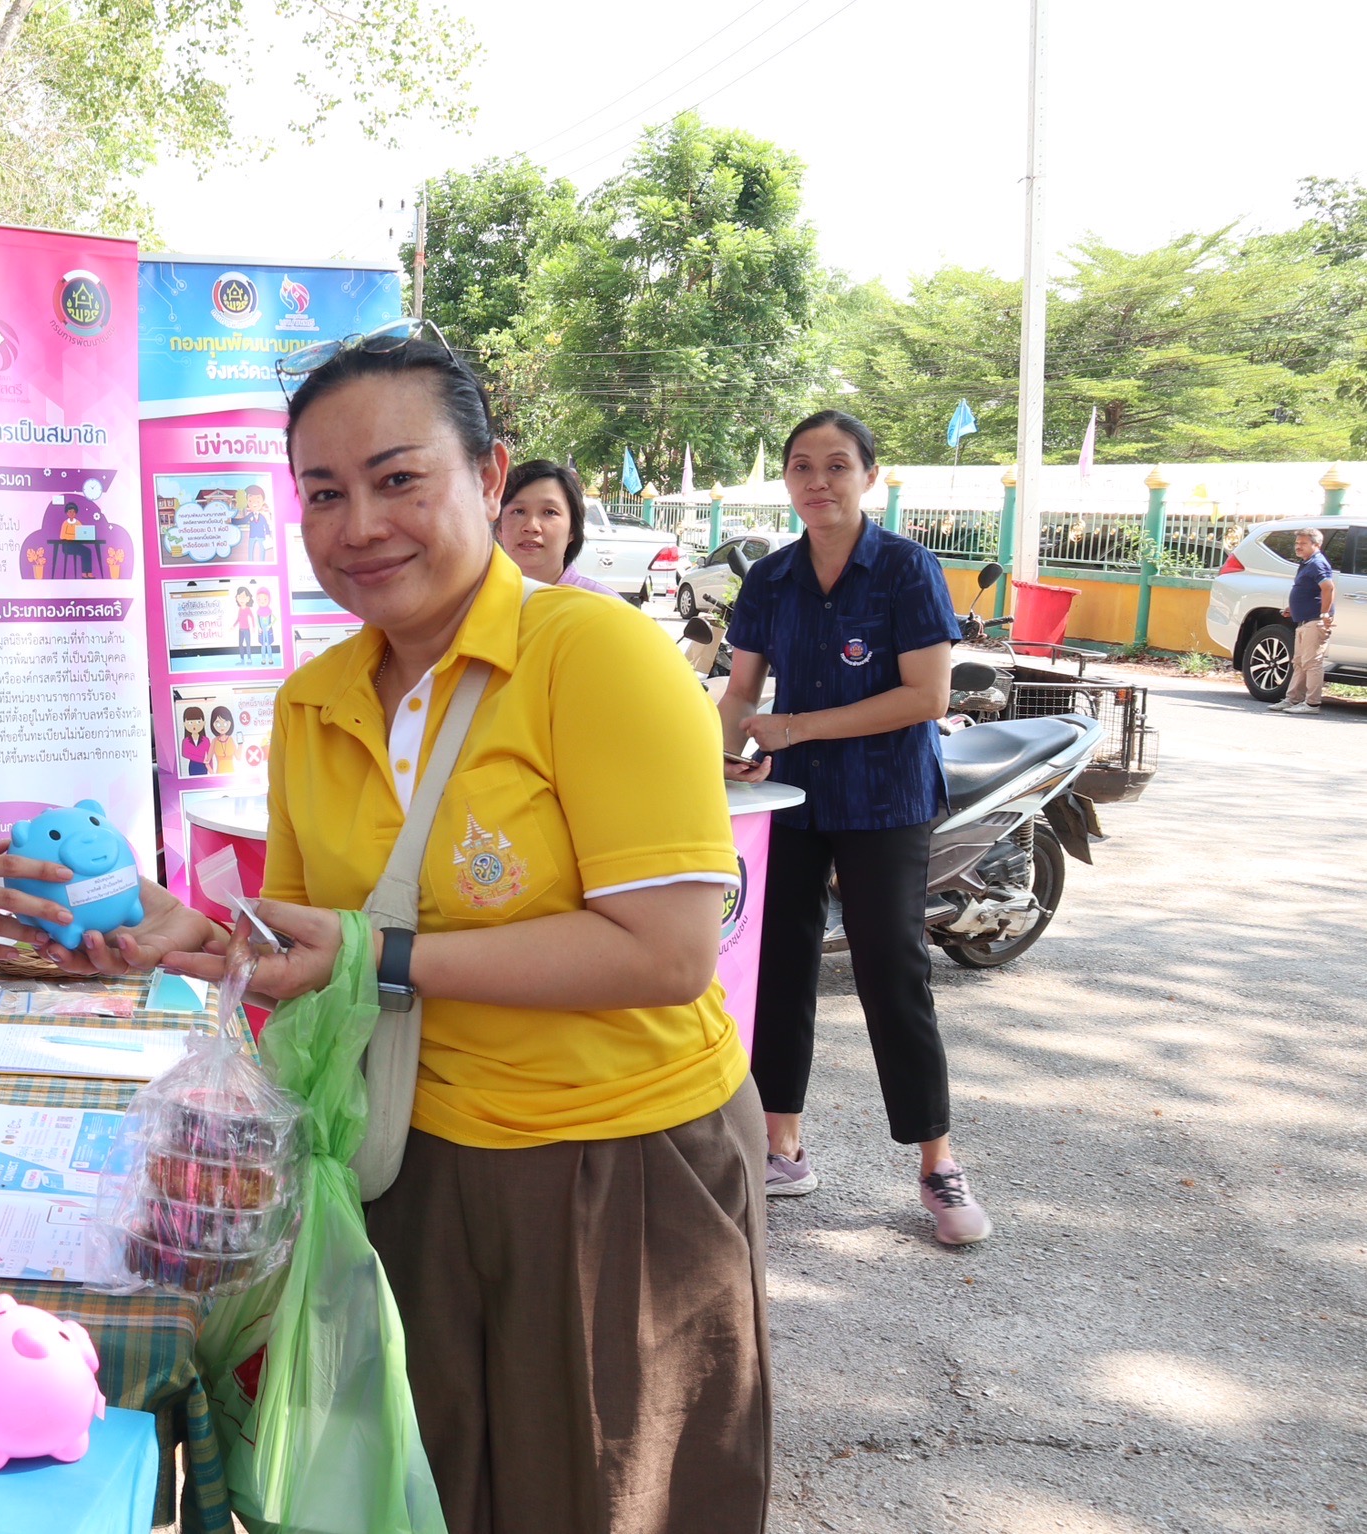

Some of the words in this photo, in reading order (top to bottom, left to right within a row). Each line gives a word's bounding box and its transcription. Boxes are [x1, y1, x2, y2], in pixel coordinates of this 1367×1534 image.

[62, 650, 126, 666] ที่เป็นนิติบุคคล
